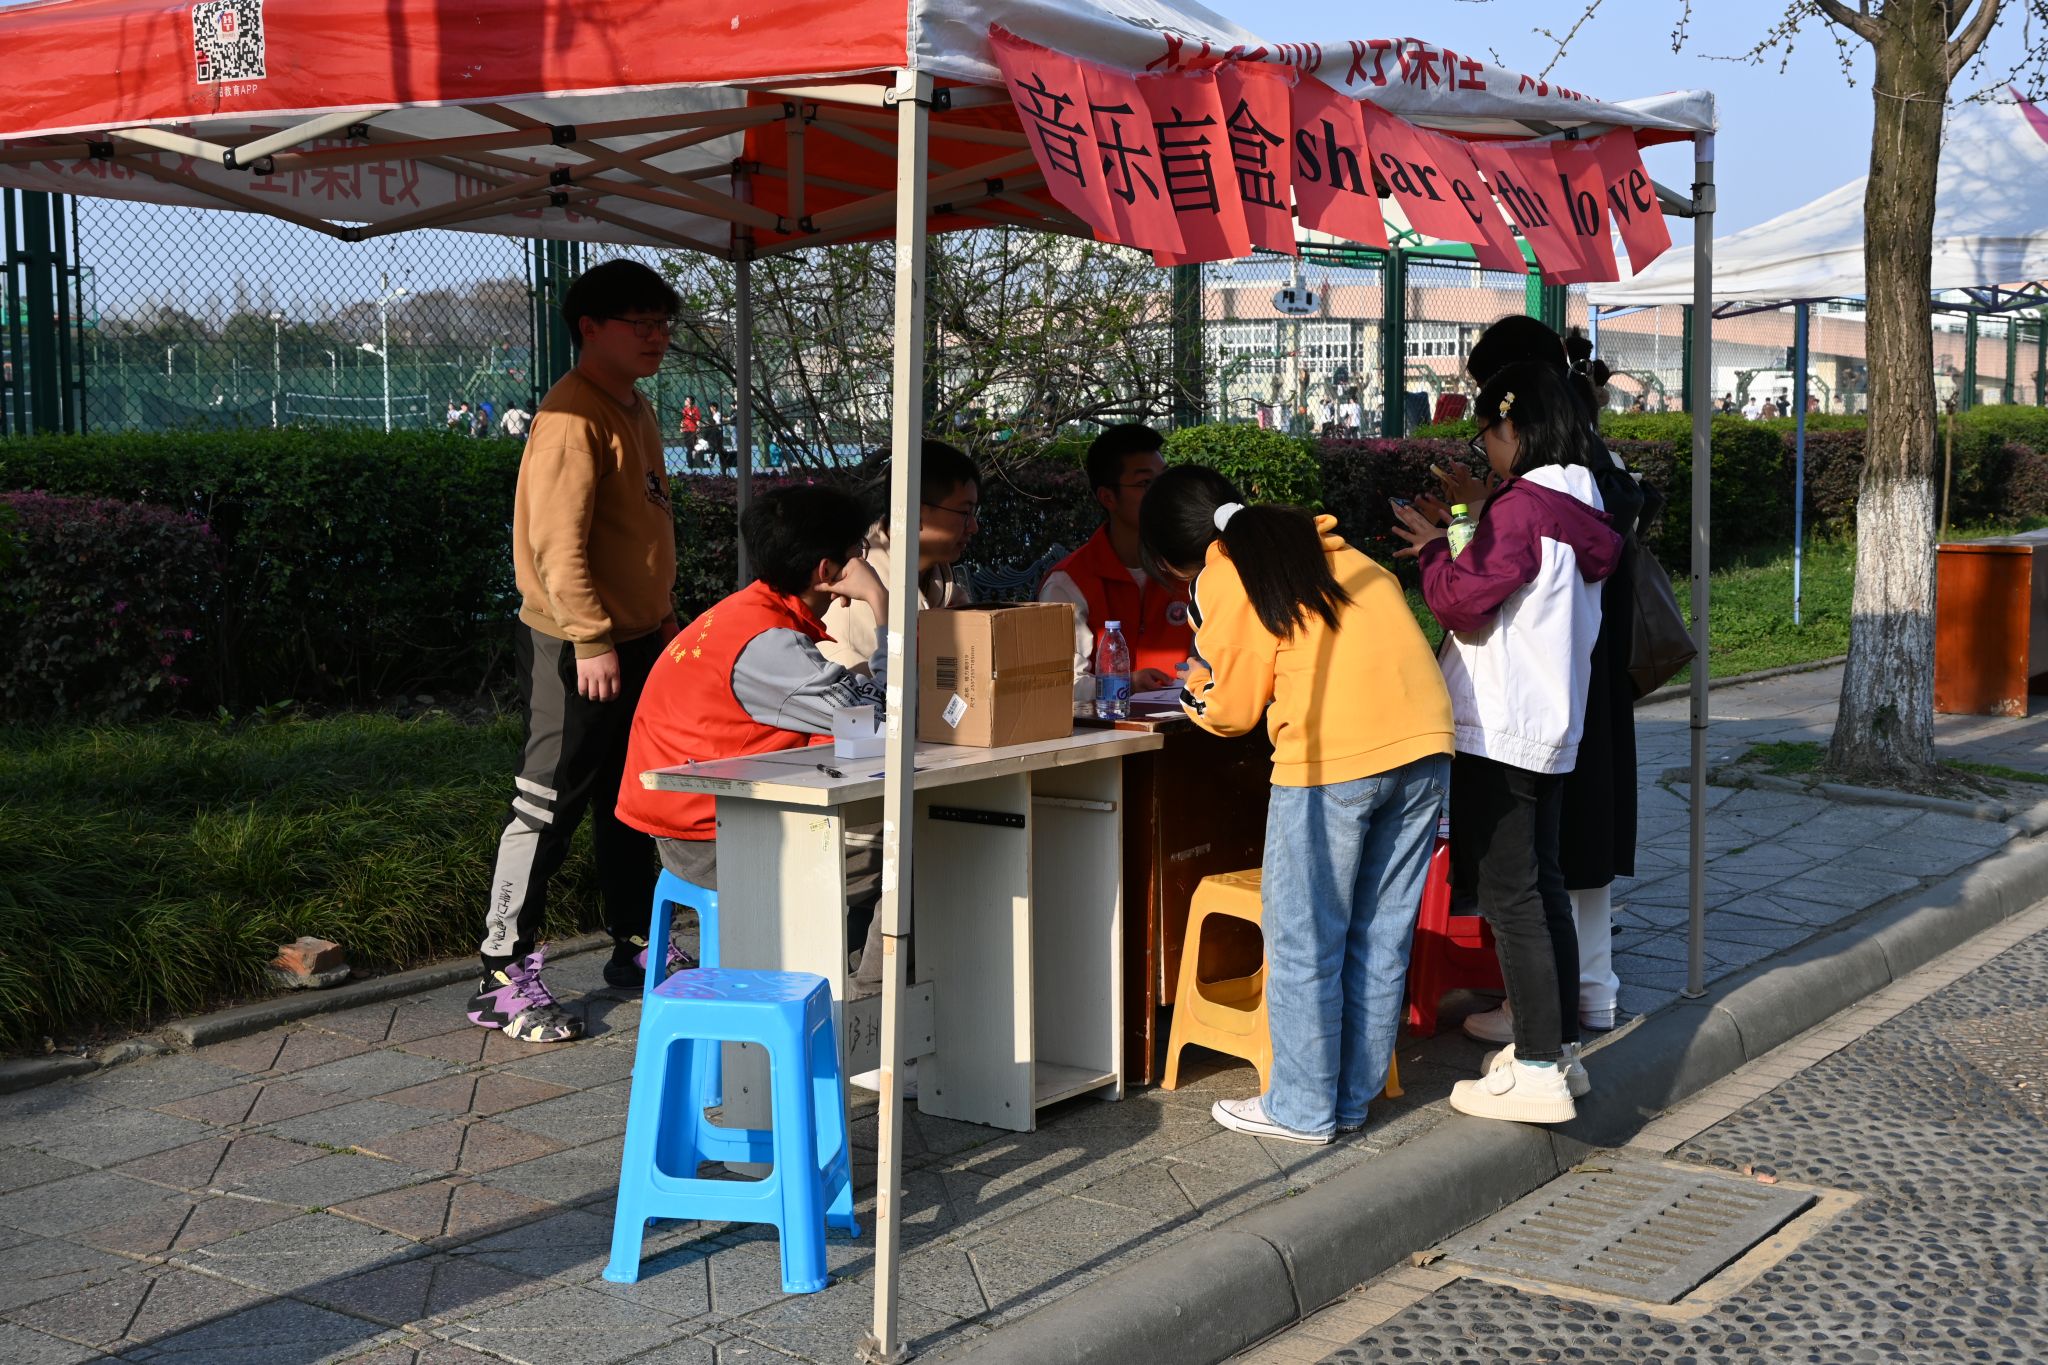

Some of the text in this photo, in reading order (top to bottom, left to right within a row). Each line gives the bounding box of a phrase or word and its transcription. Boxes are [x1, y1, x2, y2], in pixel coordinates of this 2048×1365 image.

[1015, 72, 1287, 214] 音乐盲盒
[1559, 168, 1651, 236] love
